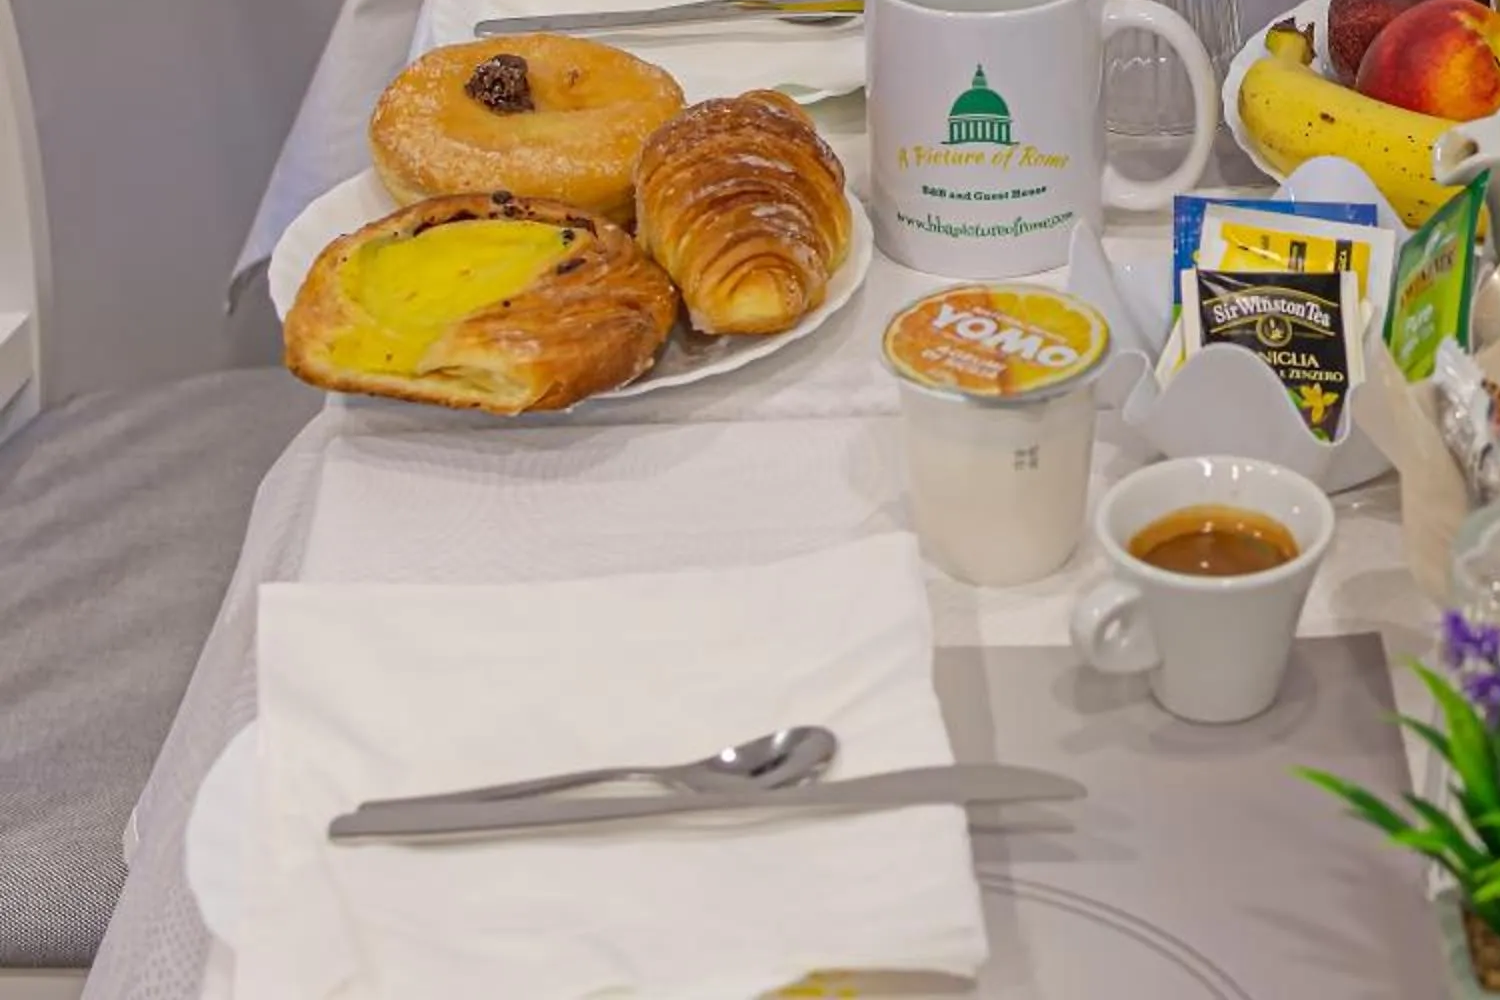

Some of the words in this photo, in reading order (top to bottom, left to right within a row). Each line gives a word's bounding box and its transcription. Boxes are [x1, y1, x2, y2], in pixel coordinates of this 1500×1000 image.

[913, 145, 985, 169] Picture
[949, 190, 971, 201] and
[973, 190, 1009, 201] Guest
[931, 303, 1078, 368] YOMO
[1259, 350, 1319, 368] NIGLIA
